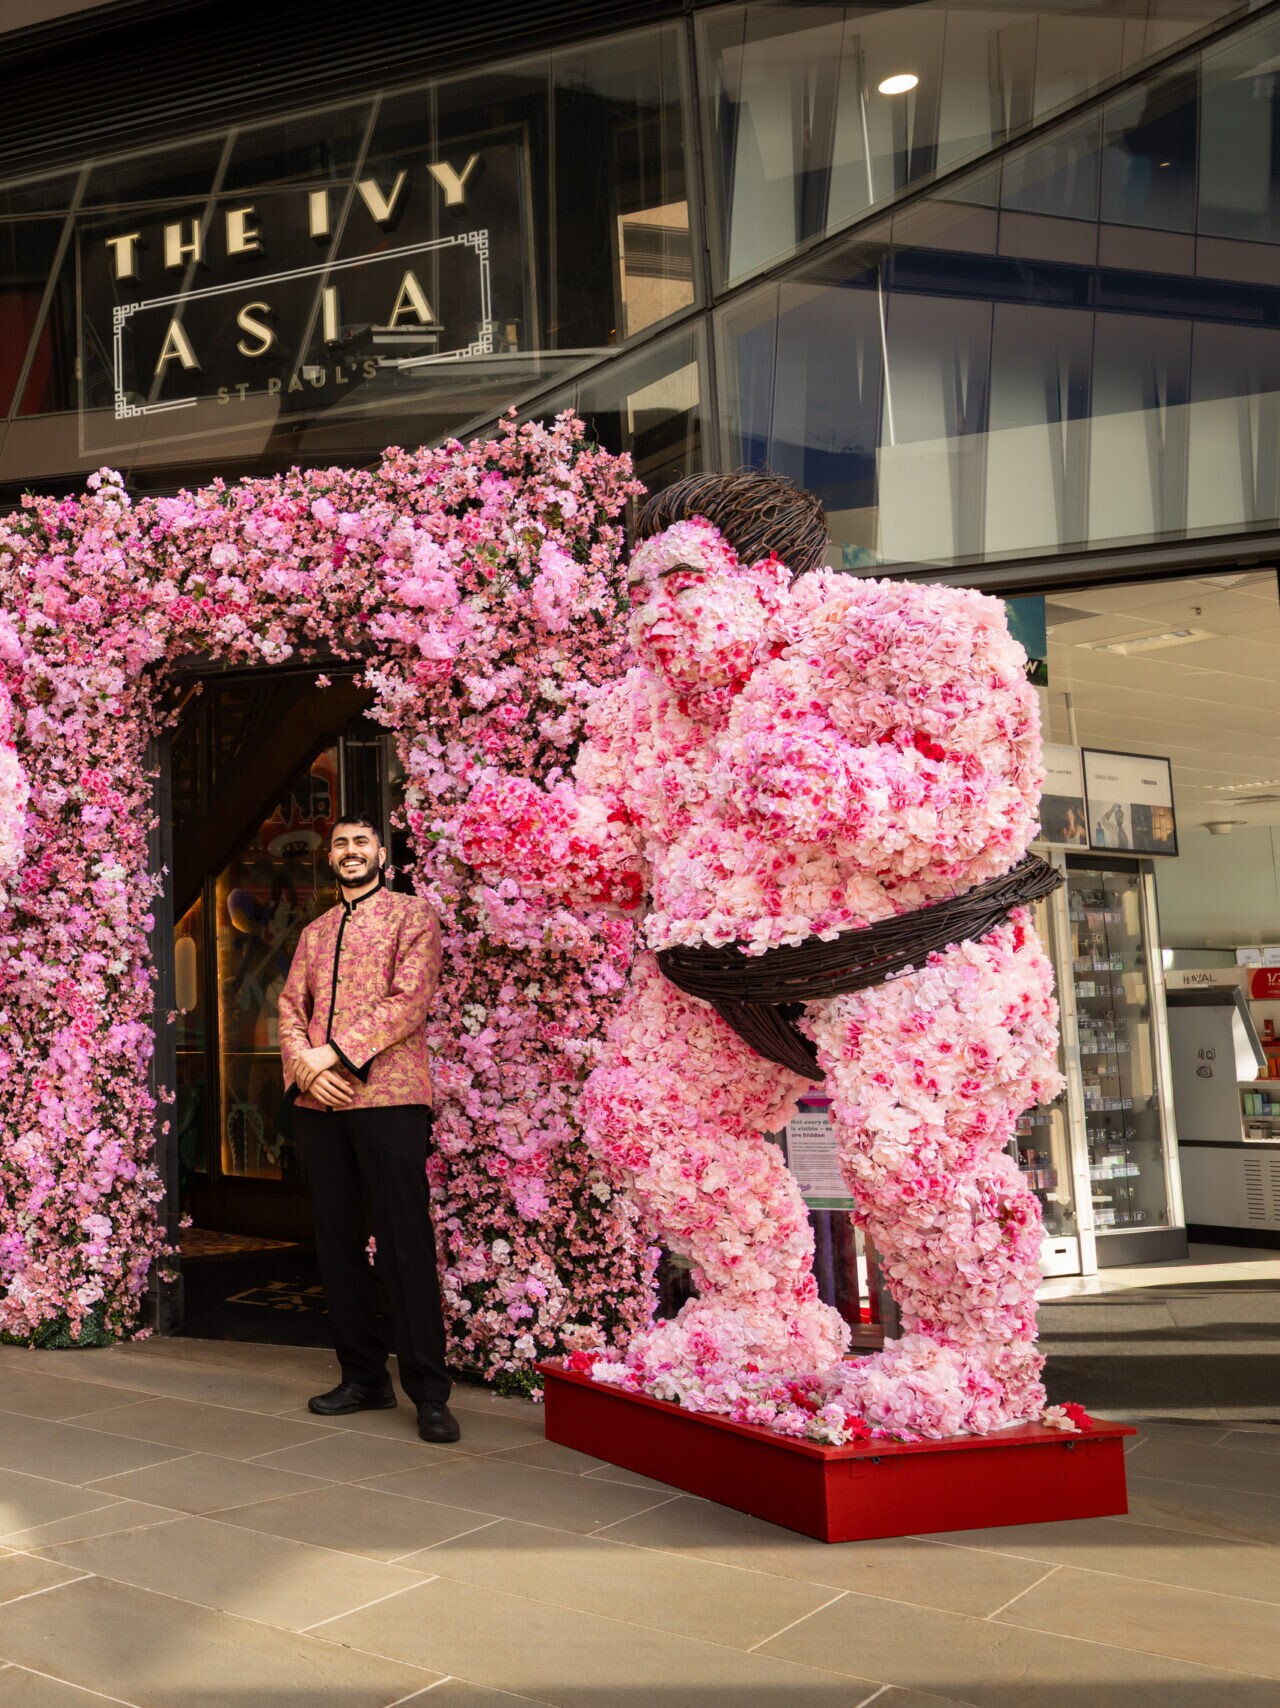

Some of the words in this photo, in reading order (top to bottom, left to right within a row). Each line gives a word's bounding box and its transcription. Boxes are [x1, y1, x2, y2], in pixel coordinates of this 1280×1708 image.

[105, 205, 263, 280] THE
[309, 153, 482, 239] IVY
[154, 270, 435, 376] ASIA
[217, 382, 250, 405] ST
[268, 360, 378, 397] PAUL'S
